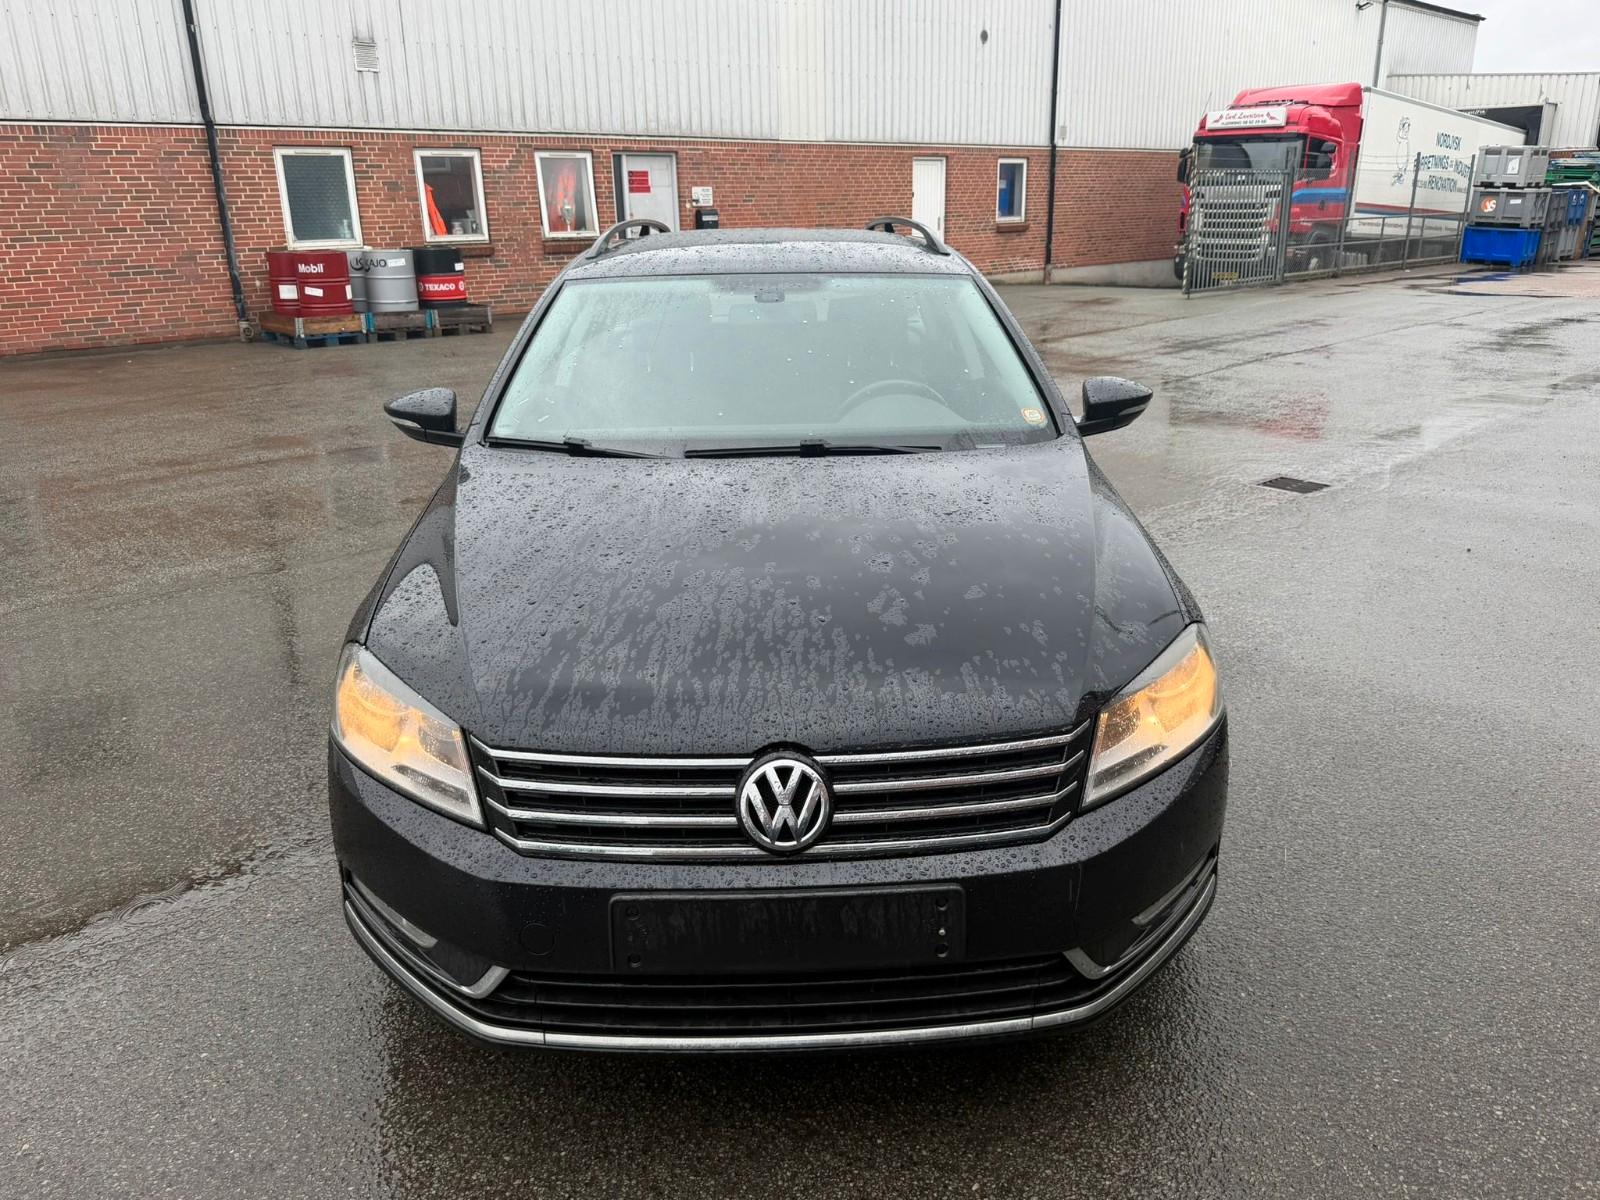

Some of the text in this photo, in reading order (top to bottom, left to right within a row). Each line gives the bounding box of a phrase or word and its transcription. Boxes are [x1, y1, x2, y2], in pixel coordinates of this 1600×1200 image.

[1436, 132, 1462, 151] NORDJYSK
[1427, 174, 1457, 193] RENOVATION
[298, 263, 324, 273] Mobil
[425, 283, 456, 291] TEXACO
[744, 761, 826, 847] VW
